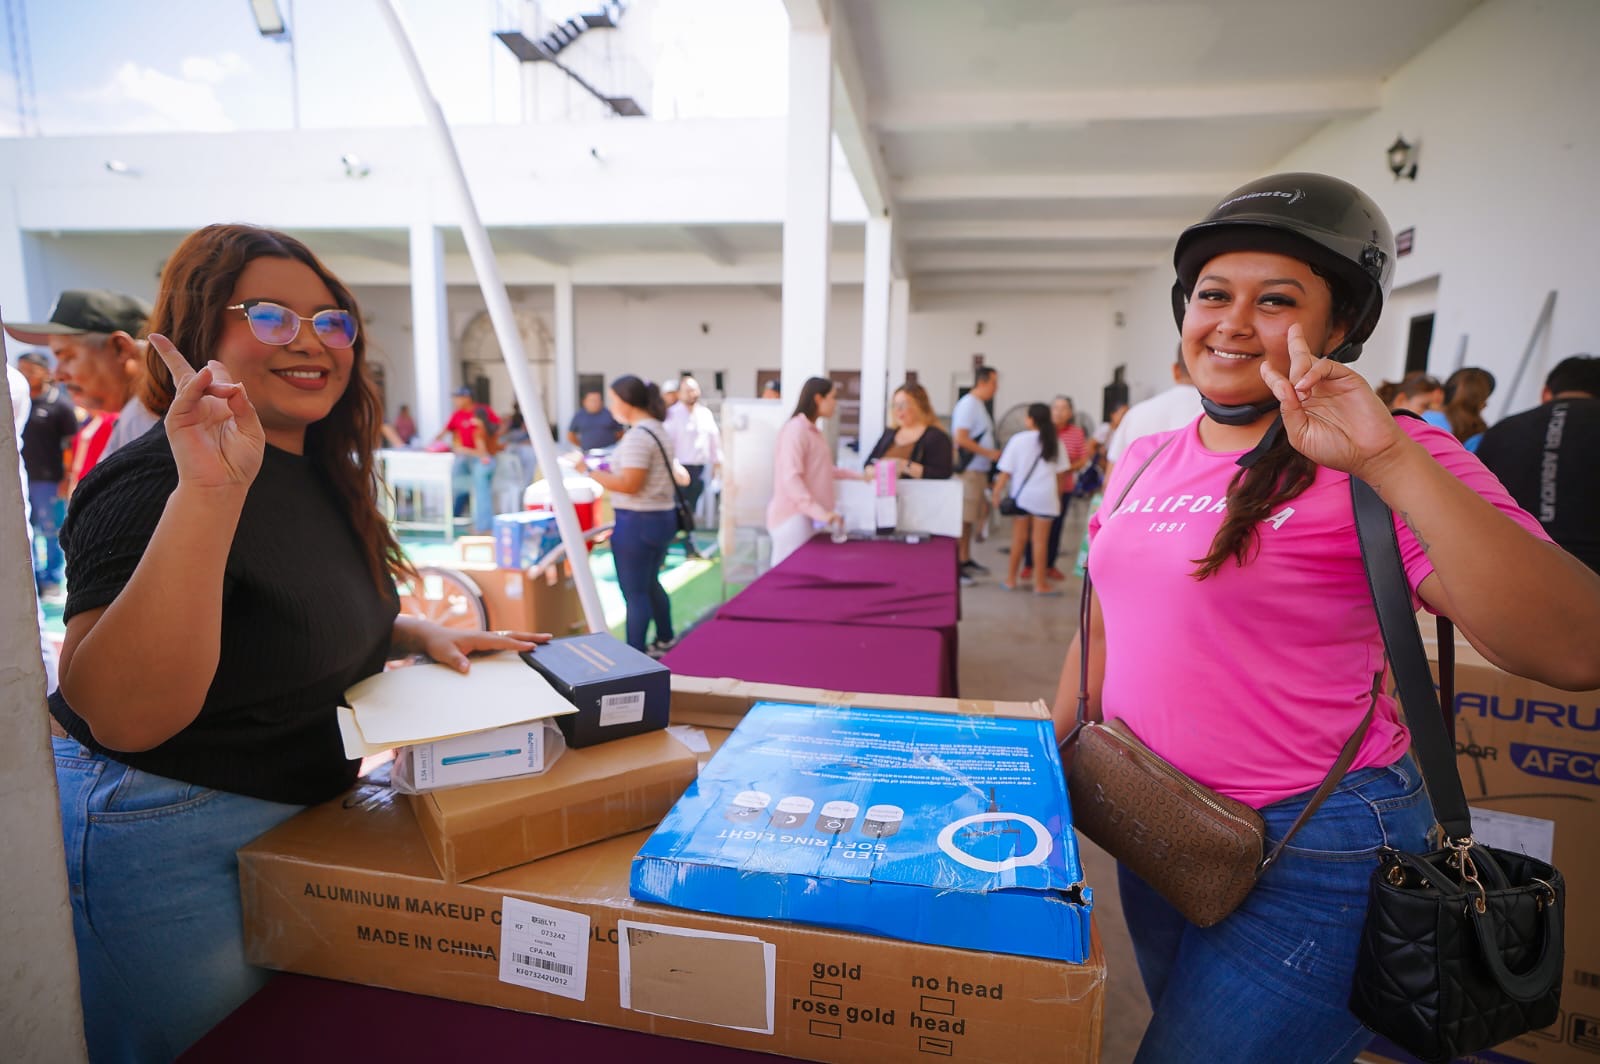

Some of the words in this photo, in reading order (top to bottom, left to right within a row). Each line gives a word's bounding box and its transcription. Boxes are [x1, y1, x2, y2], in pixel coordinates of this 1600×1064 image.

[1148, 521, 1187, 533] 1991
[1455, 691, 1600, 732] AURU
[716, 828, 776, 841] LIGHT
[780, 835, 828, 847] RING
[831, 841, 887, 851] SOFT
[842, 850, 884, 860] LED
[303, 882, 400, 911] ALUMINUM
[405, 897, 486, 922] MAKEUP
[356, 925, 409, 947] MADE
[414, 933, 432, 951] IN
[437, 938, 497, 961] CHINA
[541, 929, 566, 940] 073242
[812, 962, 862, 981] gold
[911, 975, 939, 991] no
[946, 976, 1003, 1001] head
[792, 998, 840, 1017] rose
[846, 1006, 895, 1026] gold
[910, 1011, 966, 1036] head
